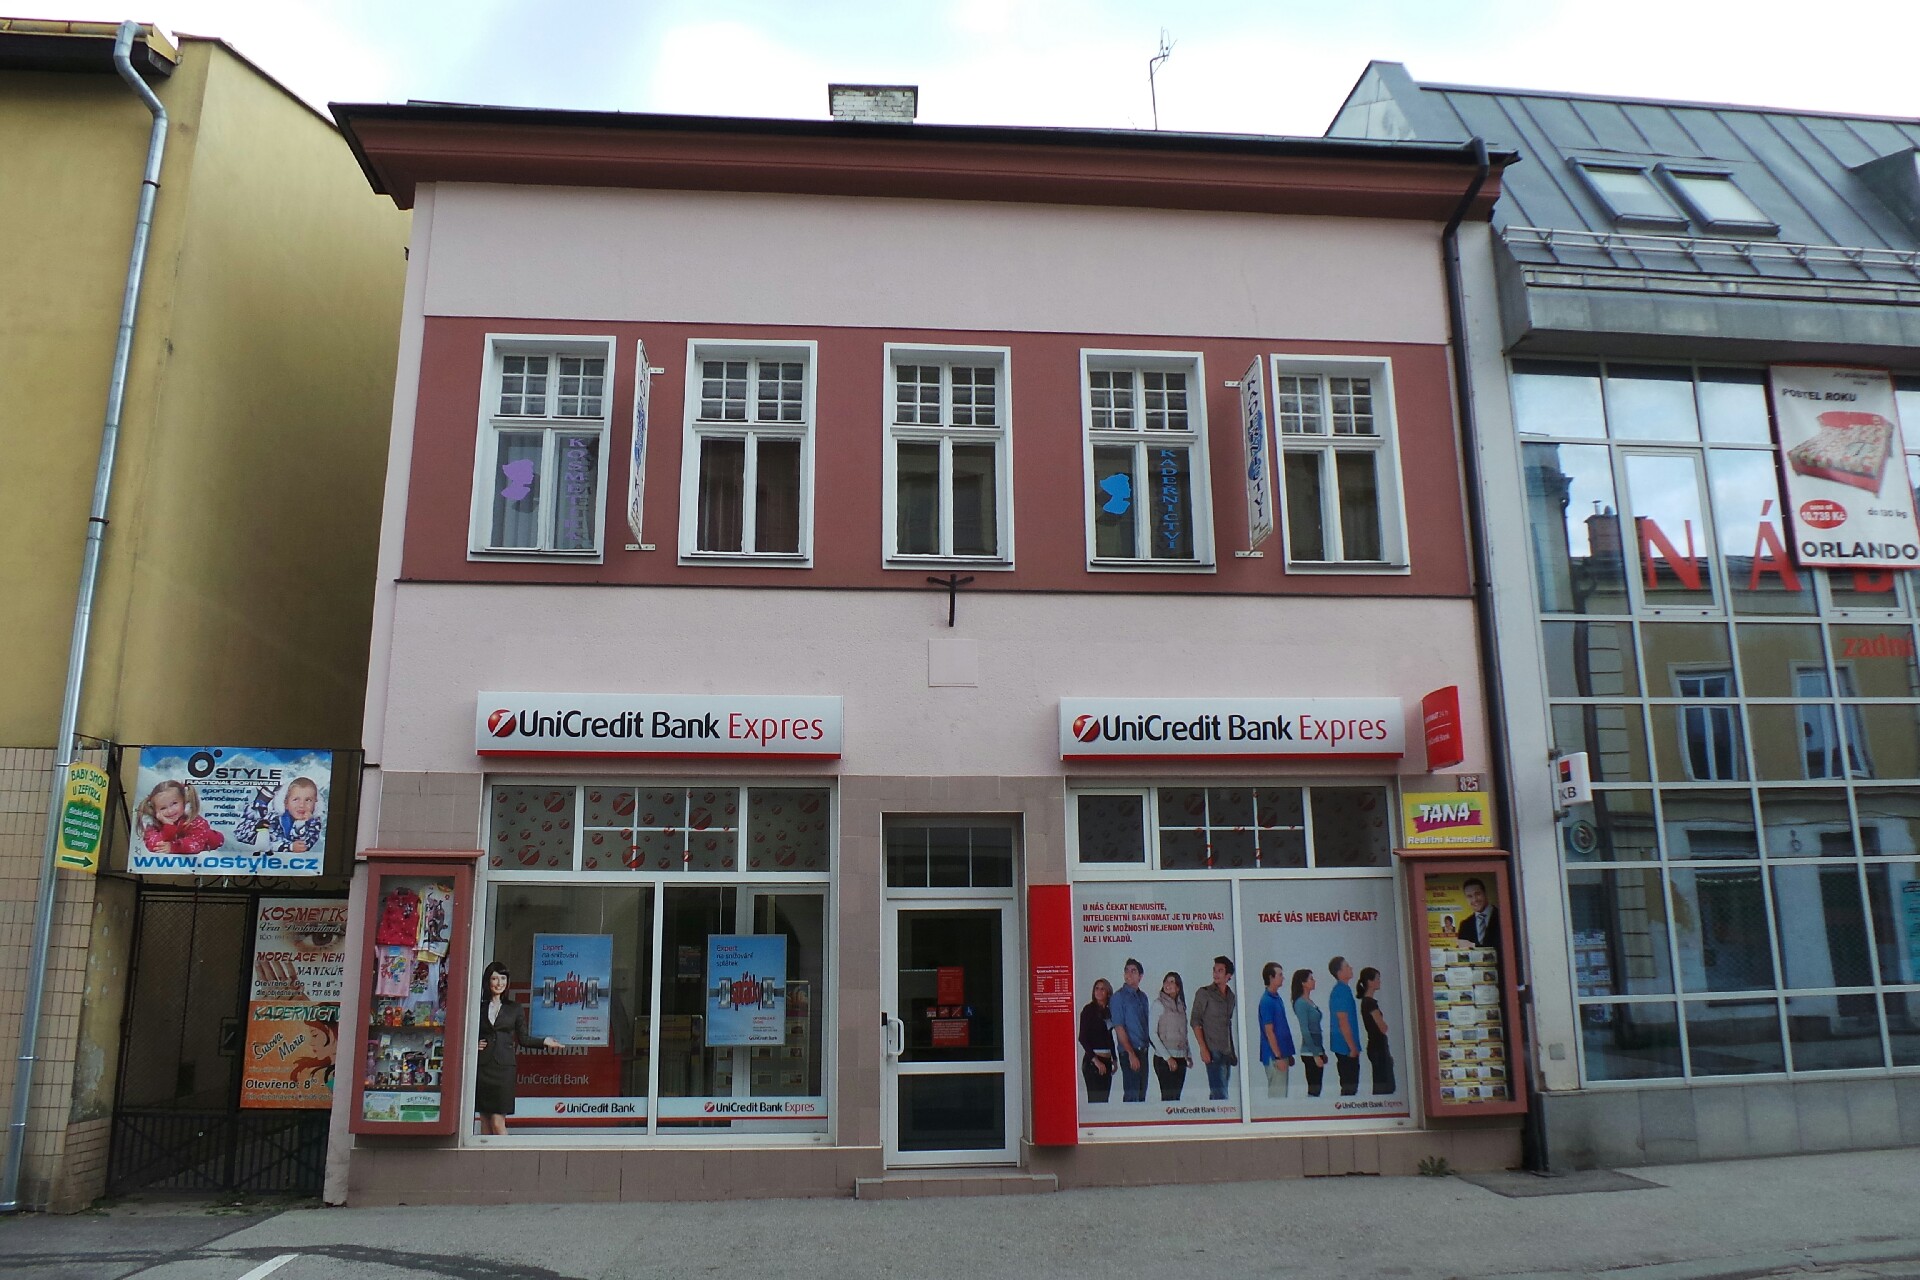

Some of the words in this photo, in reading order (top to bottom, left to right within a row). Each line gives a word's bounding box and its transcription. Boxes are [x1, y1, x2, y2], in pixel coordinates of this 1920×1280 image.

[1782, 387, 1822, 400] POSTEL
[1825, 391, 1857, 401] ROKU
[1801, 541, 1918, 560] ORLANDO
[518, 709, 644, 738] UniCredit
[651, 711, 721, 739] Bank
[728, 712, 824, 747] Expres
[1102, 714, 1221, 742] UniCredit
[1228, 714, 1293, 741] Bank
[1299, 714, 1388, 747] Expres
[71, 768, 88, 781] BABY
[90, 770, 107, 788] SHOP
[1459, 776, 1479, 792] 825
[72, 786, 77, 796] U
[201, 787, 246, 795] sportovní
[1559, 786, 1577, 799] KB
[1419, 802, 1471, 824] TANA
[1408, 836, 1442, 845] Realitní
[134, 855, 319, 873] www.ostyle.cz
[1089, 902, 1104, 911] NÁS
[1106, 902, 1129, 911] ČEKAT
[1130, 901, 1167, 911] NEMUSÍTE,
[260, 906, 348, 922] KOSMETIK
[1083, 913, 1131, 922] INTELIGENTNÍ
[1132, 913, 1170, 921] BANKOMAT
[1172, 913, 1181, 921] JE
[1208, 911, 1224, 920] VÁS!
[1258, 911, 1283, 923] TAKÉ
[1284, 911, 1303, 923] VÁS
[1306, 910, 1341, 922] NEBAVÍ
[1343, 910, 1378, 922] ČEKAT?
[1083, 924, 1105, 933] NAVÍC
[1113, 922, 1149, 932] MOŽNOSTÍ
[1151, 923, 1184, 932] NEJENOM
[1083, 935, 1097, 943] ALE
[1103, 932, 1132, 943] VKLADŮ.
[256, 951, 319, 962] MODELACE
[278, 1034, 306, 1060] Marie
[516, 1073, 562, 1085] UniCredit
[564, 1074, 589, 1085] Bank
[567, 1102, 609, 1113] UniCredit
[611, 1103, 635, 1113] Bank
[716, 1102, 758, 1112] UniCredit
[760, 1102, 783, 1112] Bank
[785, 1102, 815, 1114] Expres
[1217, 1106, 1237, 1114] Expres
